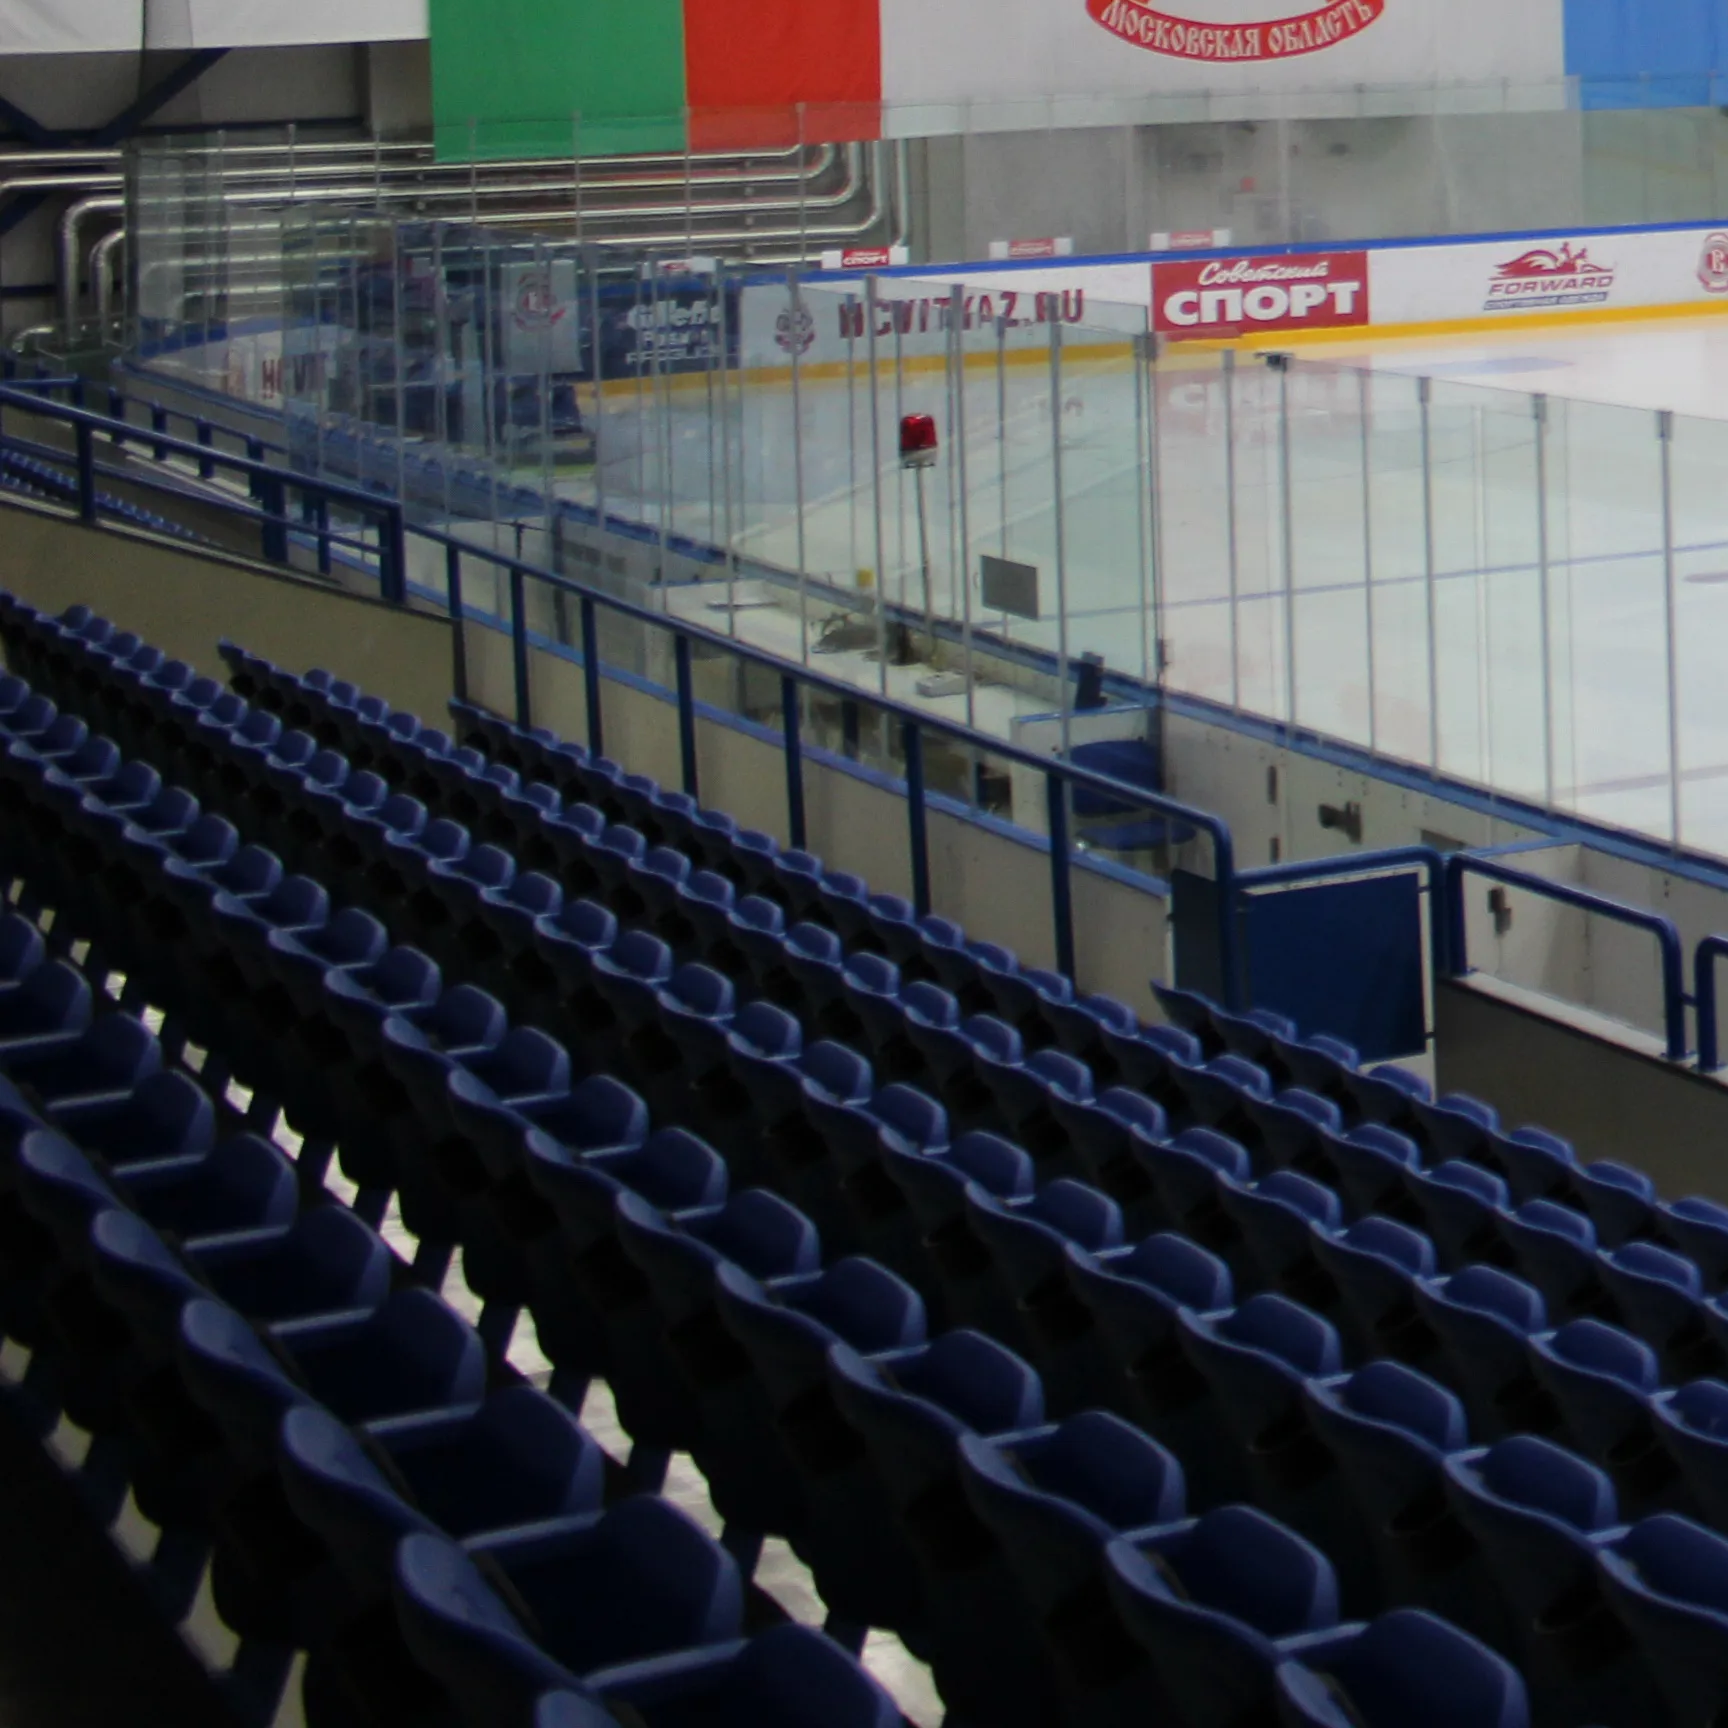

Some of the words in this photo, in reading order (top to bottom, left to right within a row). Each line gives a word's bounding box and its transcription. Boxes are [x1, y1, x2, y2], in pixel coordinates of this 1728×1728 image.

[1198, 259, 1330, 286] Советский
[1488, 275, 1615, 296] FORWARD
[1163, 280, 1360, 326] СПОРТ
